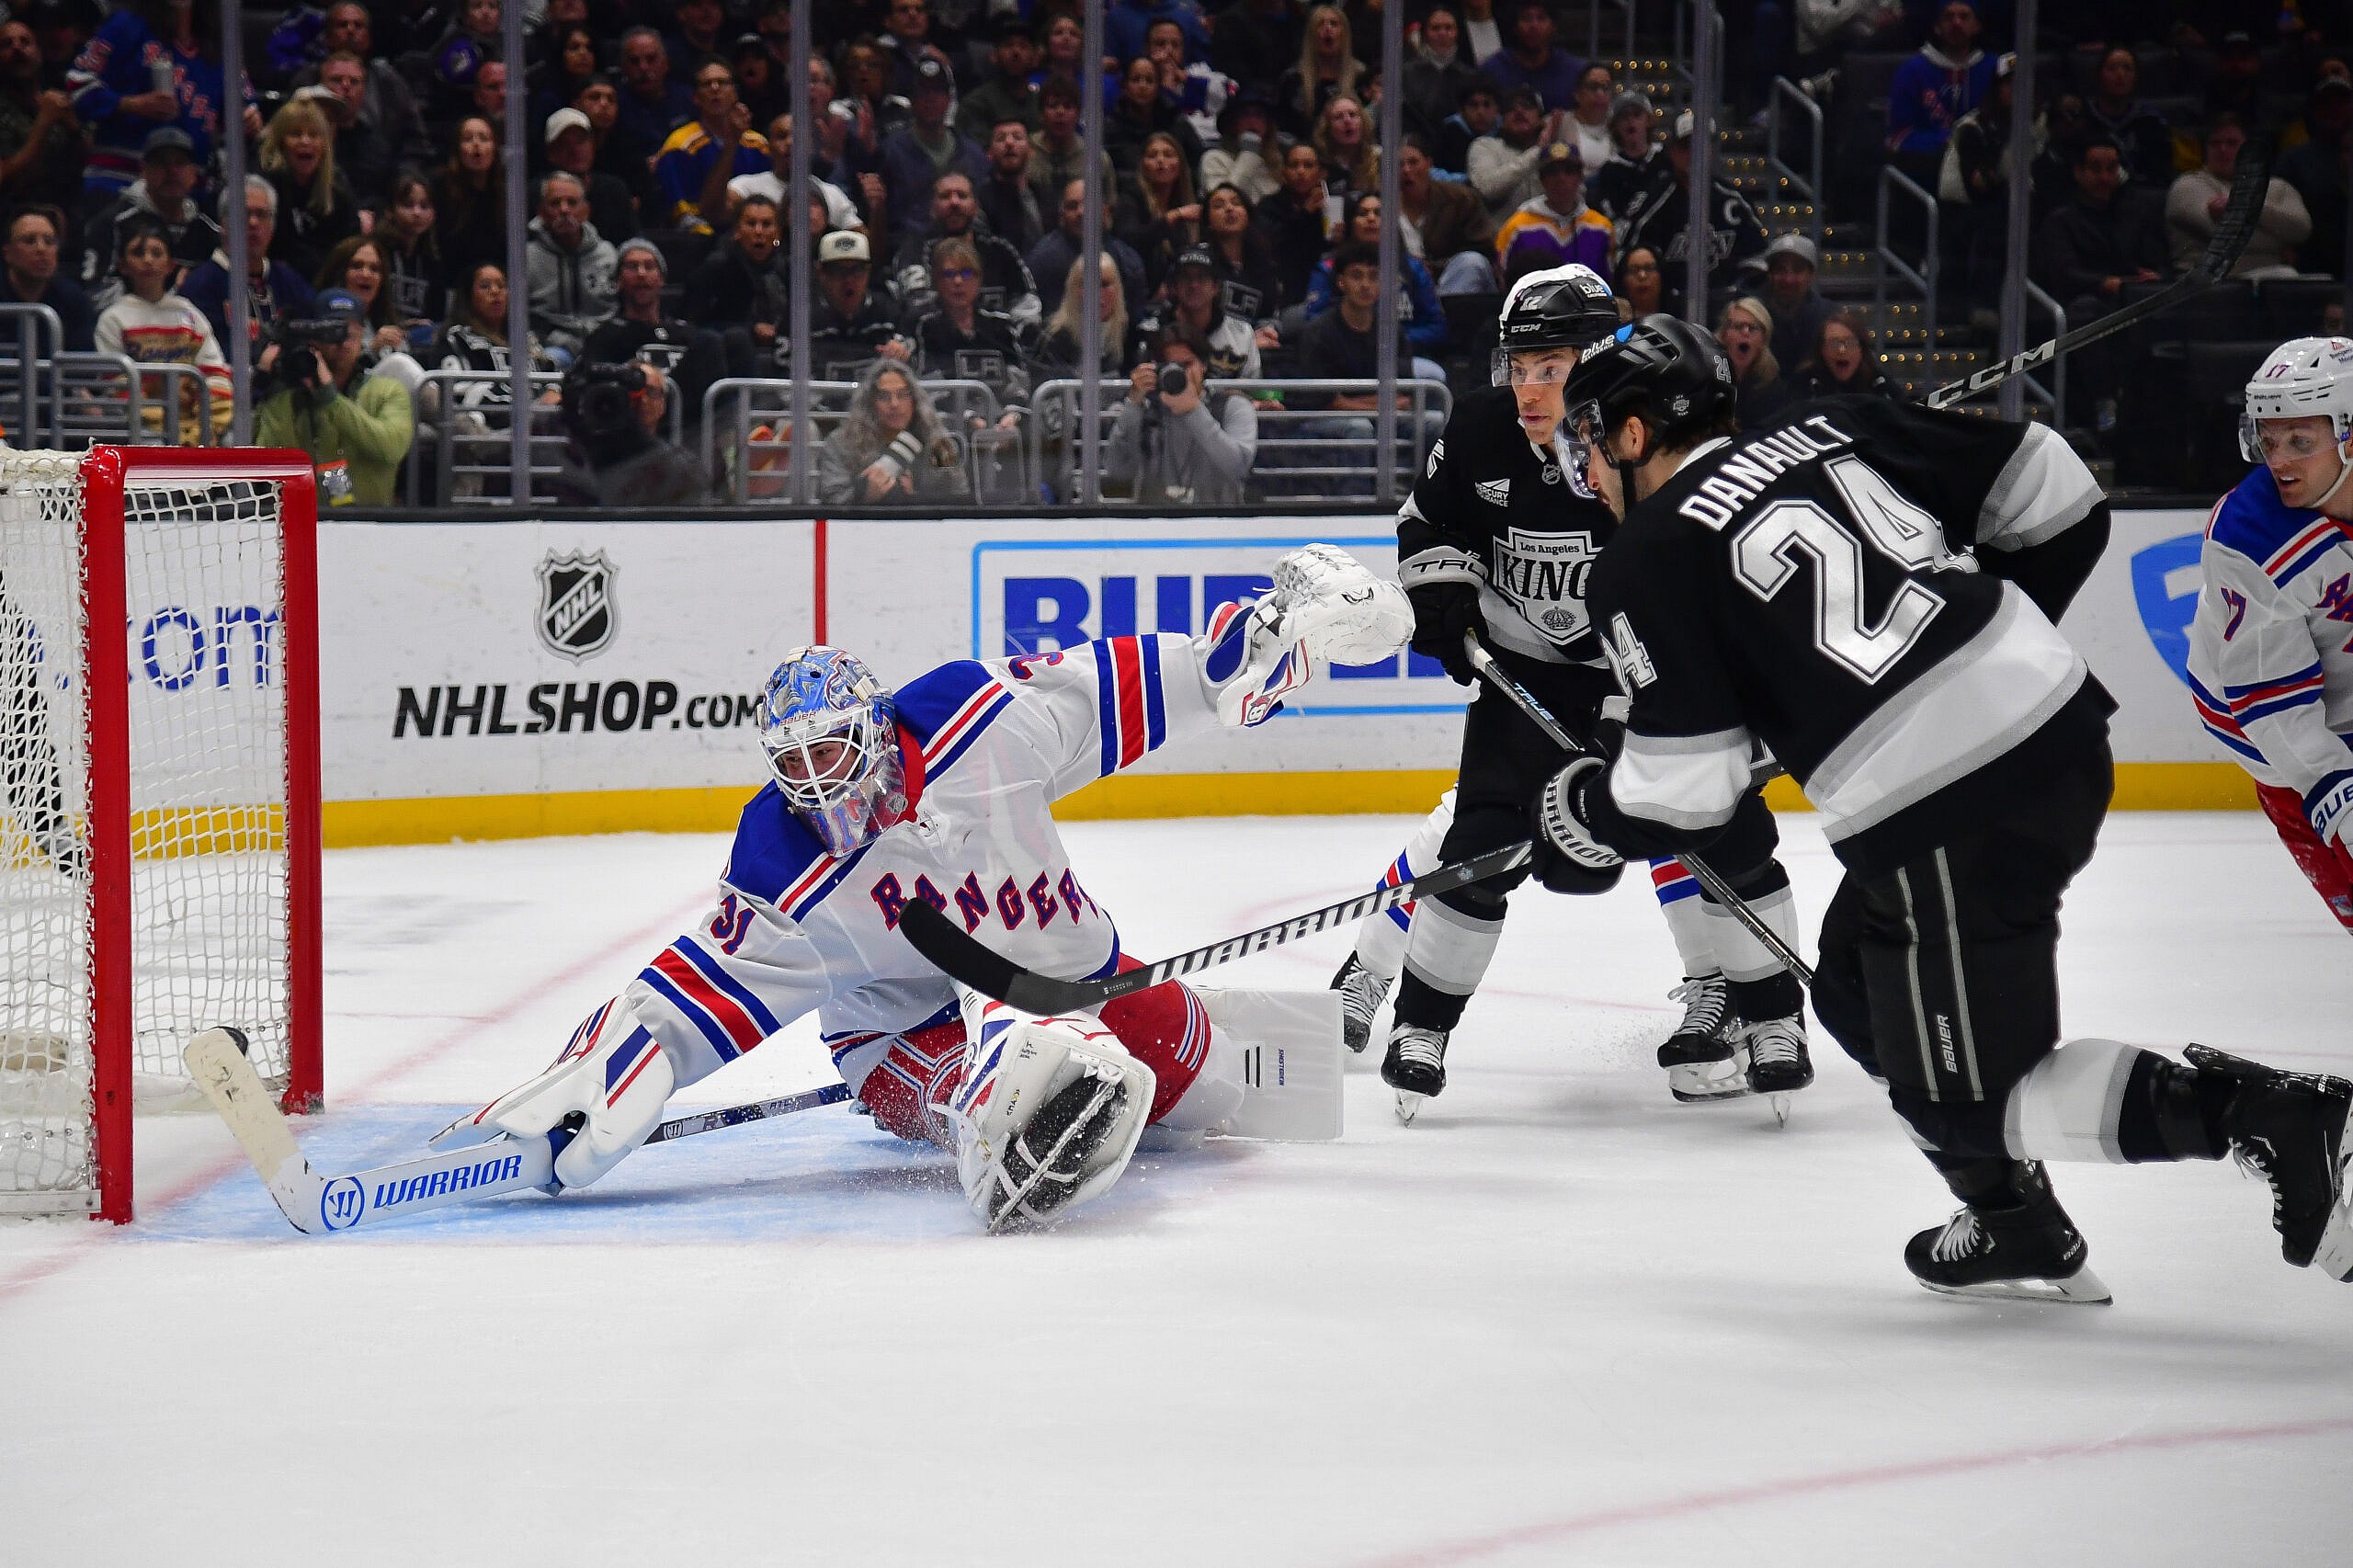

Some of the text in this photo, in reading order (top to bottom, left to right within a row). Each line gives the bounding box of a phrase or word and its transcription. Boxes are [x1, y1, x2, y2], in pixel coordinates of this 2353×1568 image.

[1519, 295, 1542, 311] 12
[1578, 282, 1605, 294] blue
[1511, 323, 1542, 333] CCM
[1580, 333, 1615, 361] blue
[1713, 355, 1732, 383] 24
[1927, 339, 2056, 410] CCM
[2265, 364, 2290, 378] 17
[1678, 416, 1853, 531] DANAULT
[1520, 542, 1579, 555] Los Angeles
[1731, 453, 1979, 686] 24
[1502, 552, 1592, 601] KING
[554, 577, 603, 638] NHL
[392, 681, 762, 738] NHLSHOP.COM
[1514, 682, 1555, 722] TRUE
[870, 867, 1098, 935] RANGER
[1150, 883, 1415, 988] WARRIOR
[1937, 1014, 1959, 1074] BAUER
[373, 1154, 522, 1210] WARRIOR
